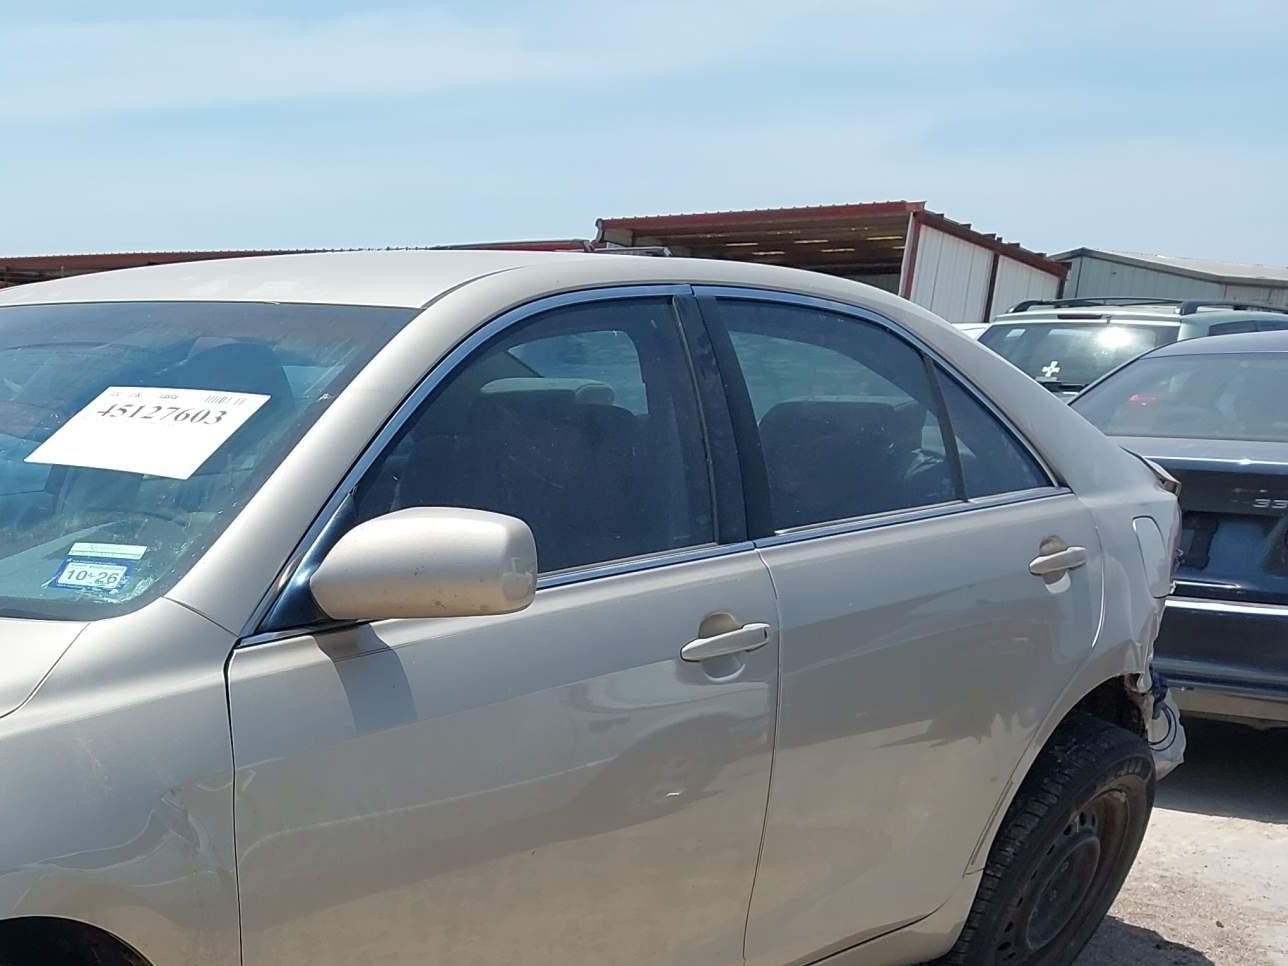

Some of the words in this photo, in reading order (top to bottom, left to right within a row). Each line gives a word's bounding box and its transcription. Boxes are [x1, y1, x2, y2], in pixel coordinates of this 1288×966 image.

[97, 403, 227, 425] 45127603
[67, 569, 88, 581] 10
[95, 571, 120, 585] 26
